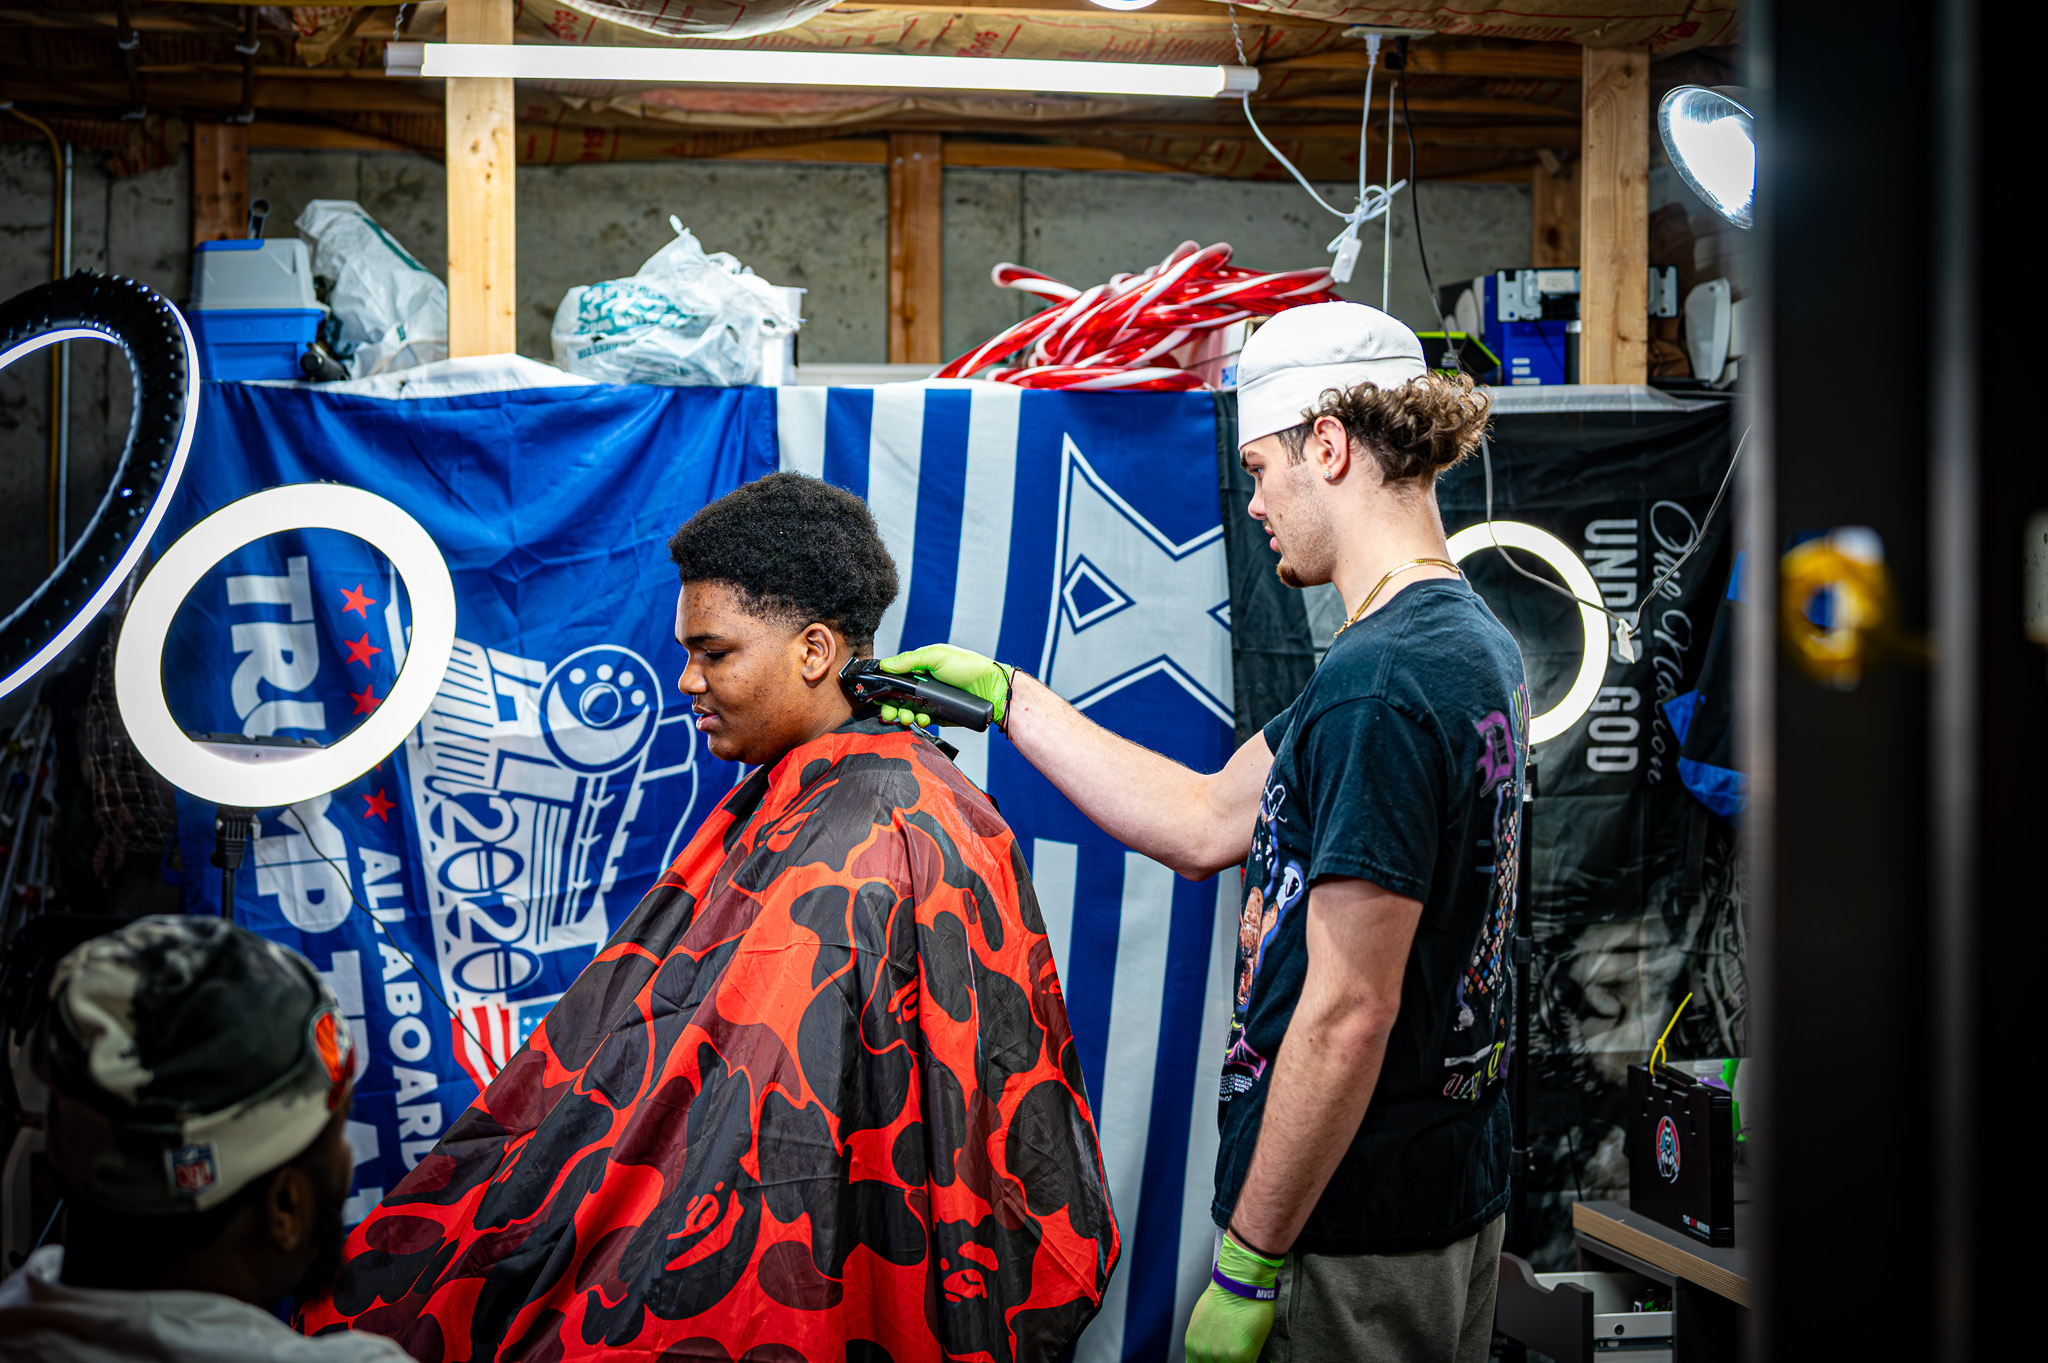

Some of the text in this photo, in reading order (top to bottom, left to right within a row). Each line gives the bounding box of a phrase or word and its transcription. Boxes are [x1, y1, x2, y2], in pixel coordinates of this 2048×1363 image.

[1649, 499, 1703, 602] One
[1586, 686, 1642, 773] GOD
[428, 791, 544, 995] 2020
[358, 845, 444, 1172] ALL ABOARD
